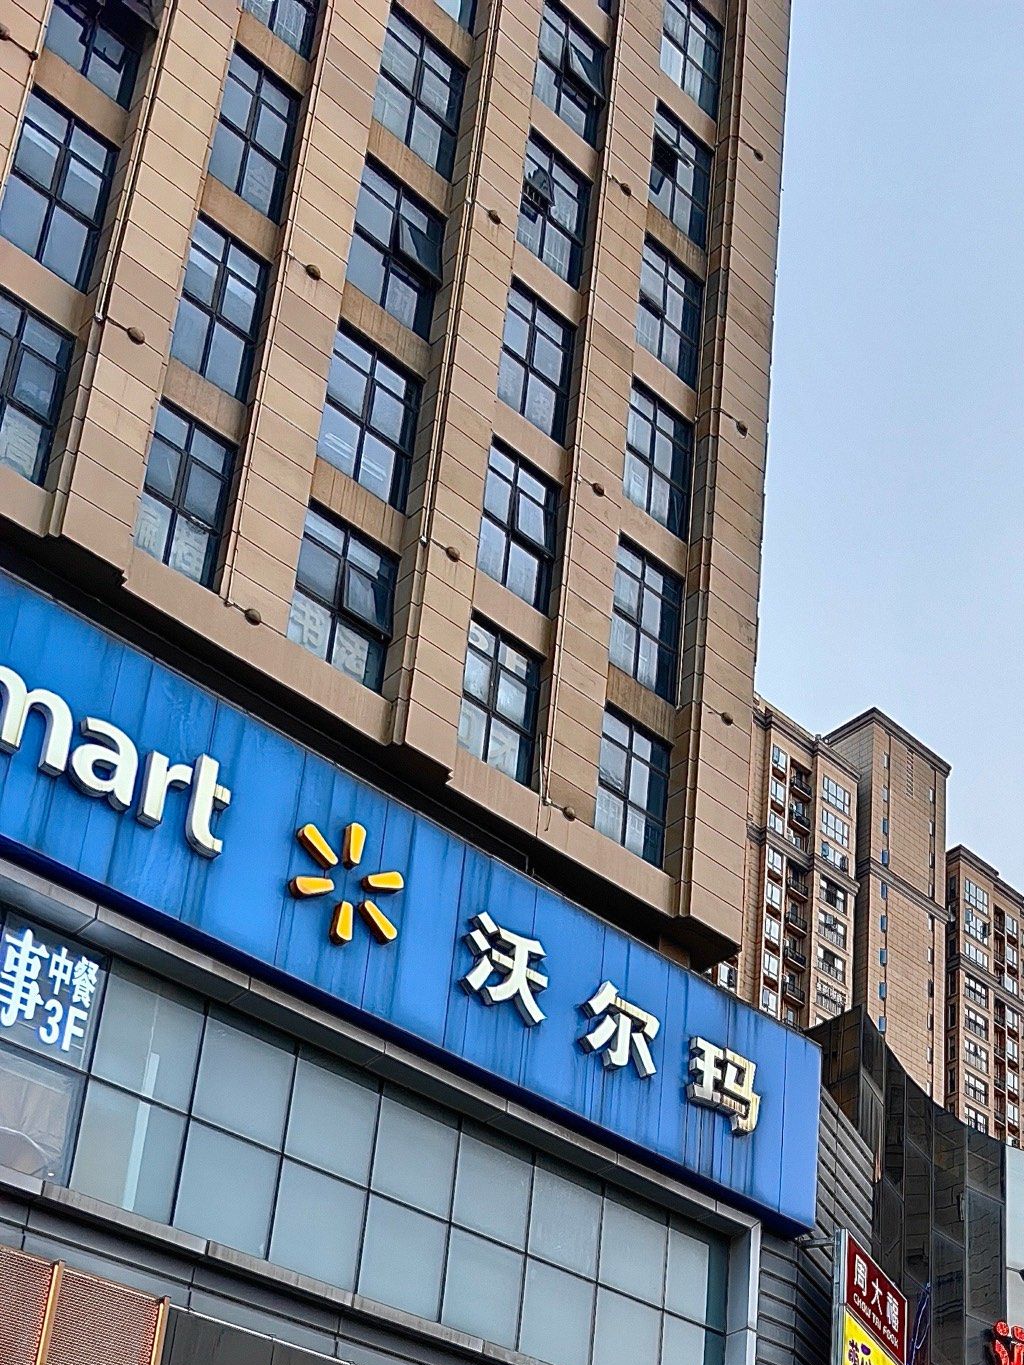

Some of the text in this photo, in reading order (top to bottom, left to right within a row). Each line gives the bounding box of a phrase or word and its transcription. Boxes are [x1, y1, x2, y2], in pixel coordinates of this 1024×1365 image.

[49, 947, 99, 1008] 中餐
[39, 999, 88, 1051] 3F
[460, 911, 761, 1135] 沃尔玛
[853, 1293, 899, 1349] CHOW TAI FOOK
[854, 1254, 899, 1333] 周大福
